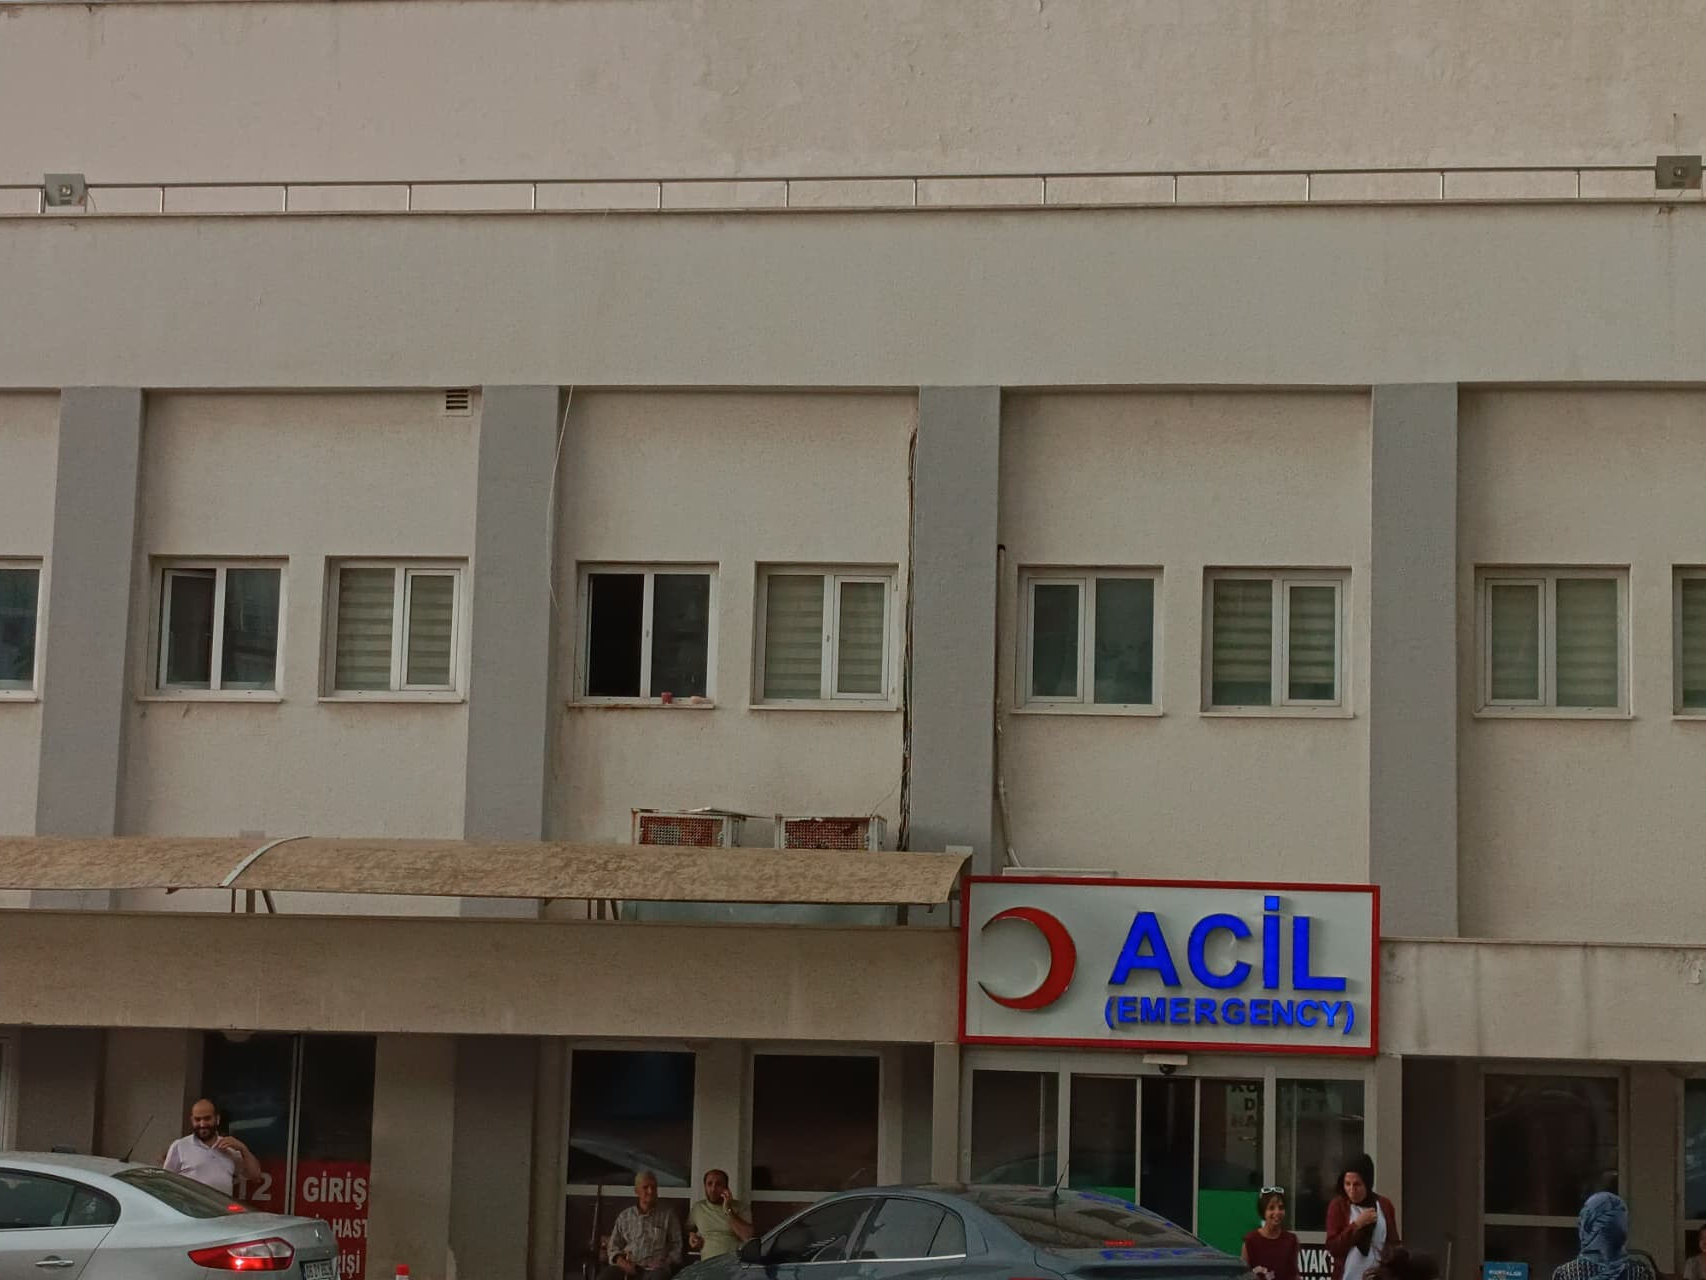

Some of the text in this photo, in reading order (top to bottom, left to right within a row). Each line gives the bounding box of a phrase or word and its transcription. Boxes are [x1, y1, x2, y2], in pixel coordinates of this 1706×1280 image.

[1107, 895, 1346, 991] ACİL
[1104, 995, 1355, 1035] (EMERGENCY)
[302, 1170, 367, 1210] GİRİŞ
